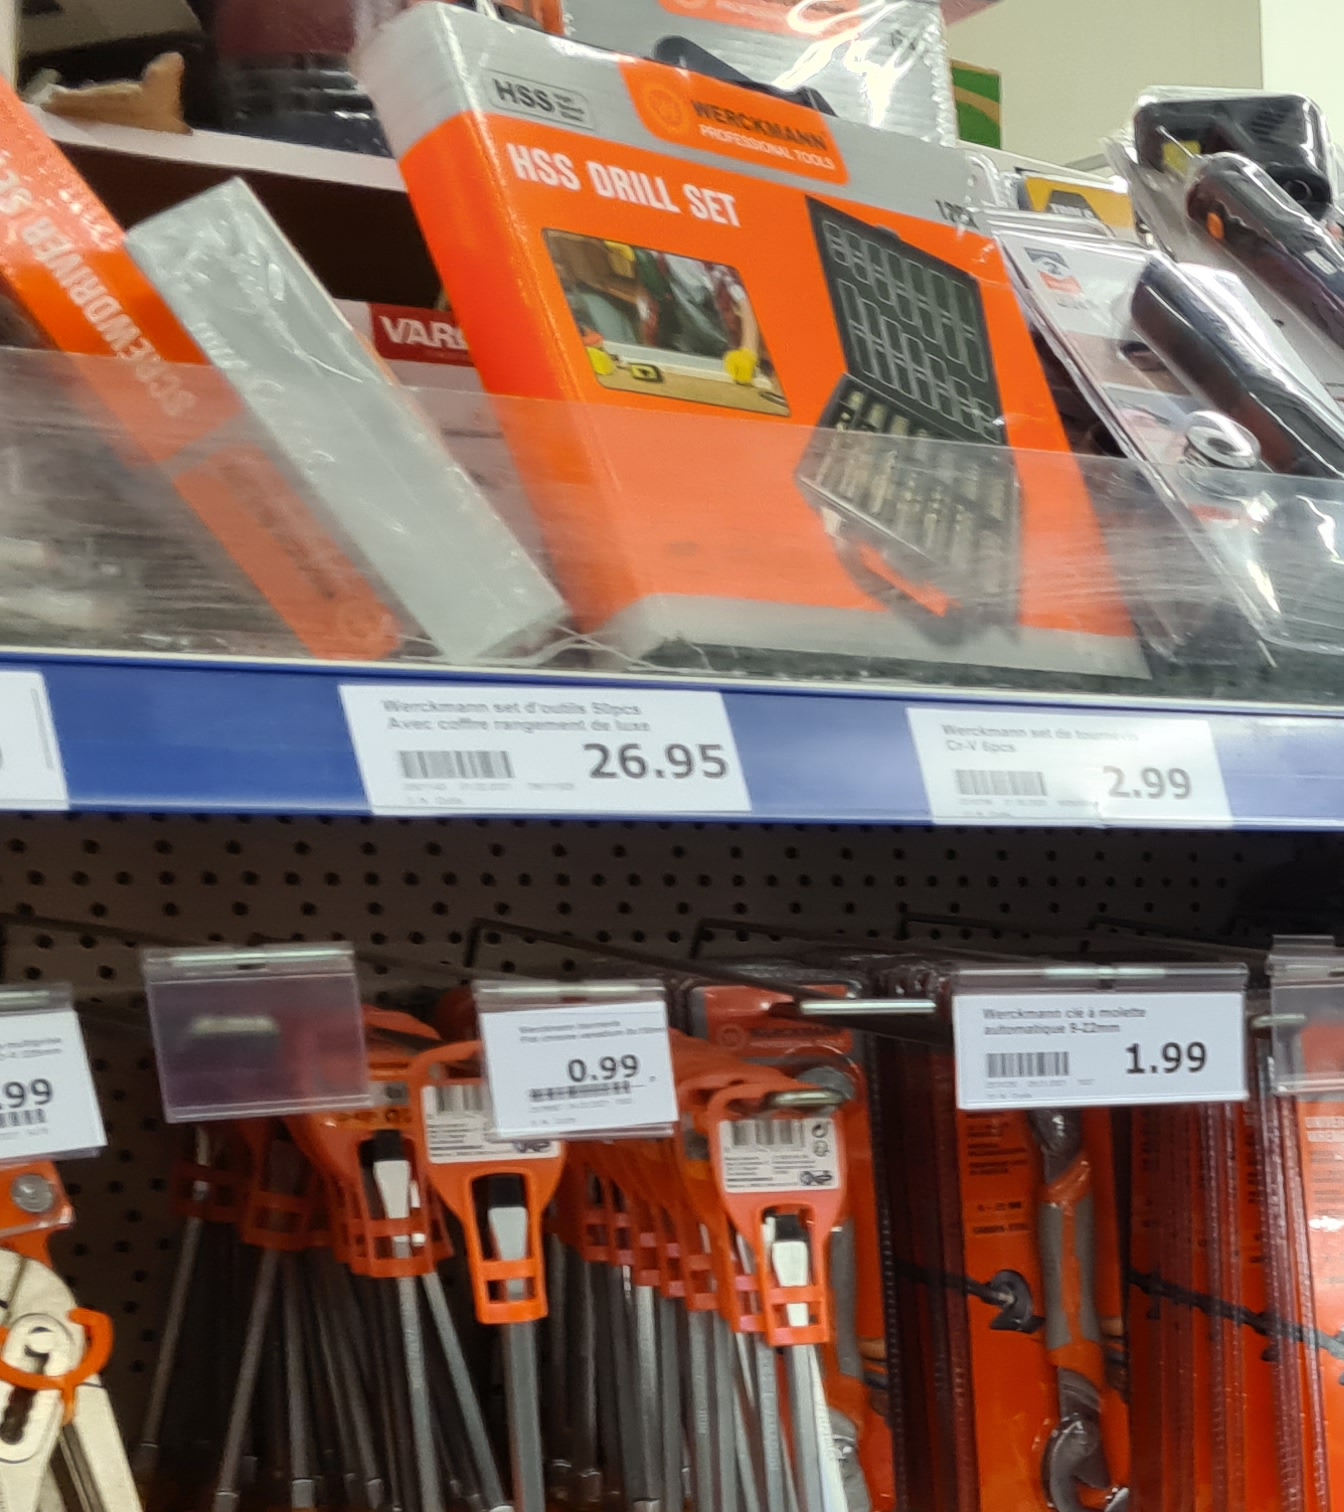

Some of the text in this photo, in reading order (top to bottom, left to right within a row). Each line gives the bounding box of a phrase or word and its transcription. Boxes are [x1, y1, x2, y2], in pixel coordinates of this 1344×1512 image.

[492, 78, 556, 114] HSS
[692, 101, 826, 152] WERCKMANN
[699, 125, 836, 171] PROFESSIONAL TOOLS
[507, 143, 743, 228] HSS DRILL SET
[383, 699, 521, 714] Werckmann set
[387, 717, 431, 731] Avec
[942, 724, 1027, 738] Werckmann
[582, 742, 730, 780] 26.95
[1103, 764, 1193, 800] 2.99
[983, 1006, 1063, 1020] Werckmann
[1099, 1006, 1147, 1020] molette
[983, 1022, 1065, 1037] automatique
[567, 1053, 640, 1083] 0.99
[1125, 1042, 1208, 1075] 1.99
